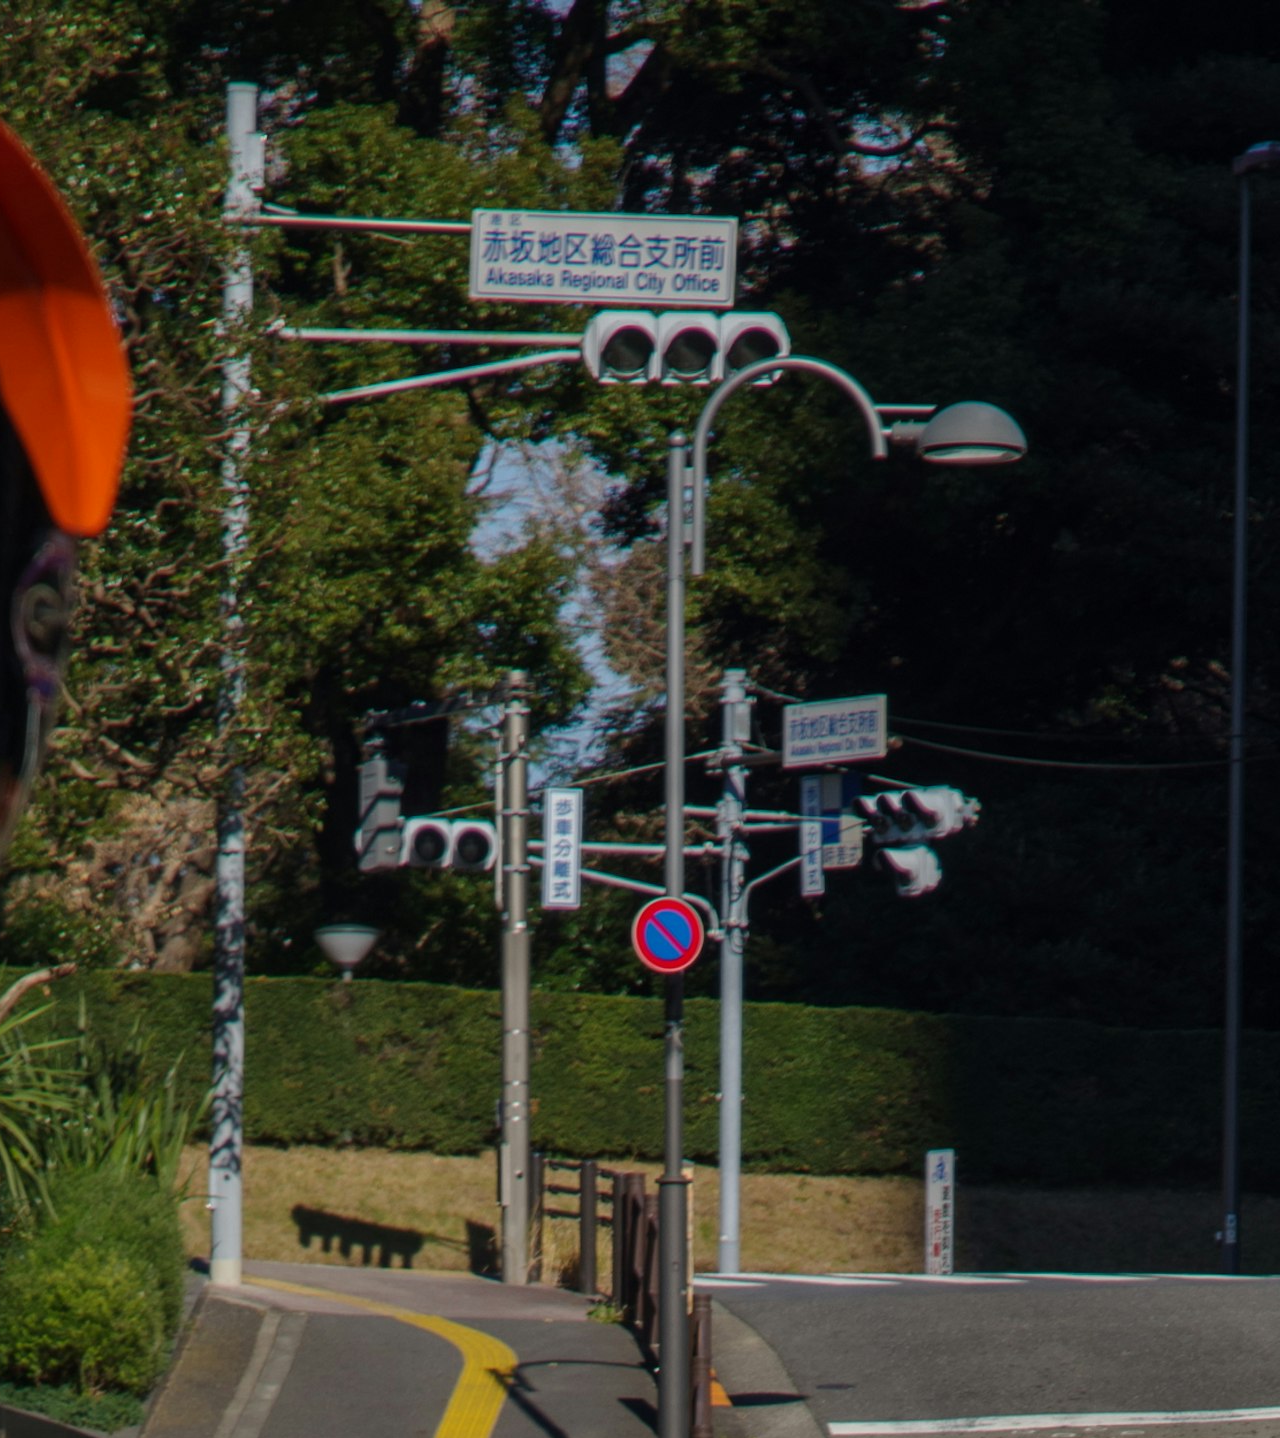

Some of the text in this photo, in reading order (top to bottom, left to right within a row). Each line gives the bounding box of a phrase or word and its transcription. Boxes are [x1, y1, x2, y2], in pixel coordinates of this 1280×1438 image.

[482, 229, 727, 271] 赤坂地区総合支所前
[486, 267, 720, 294] Akasaka Regional City Office
